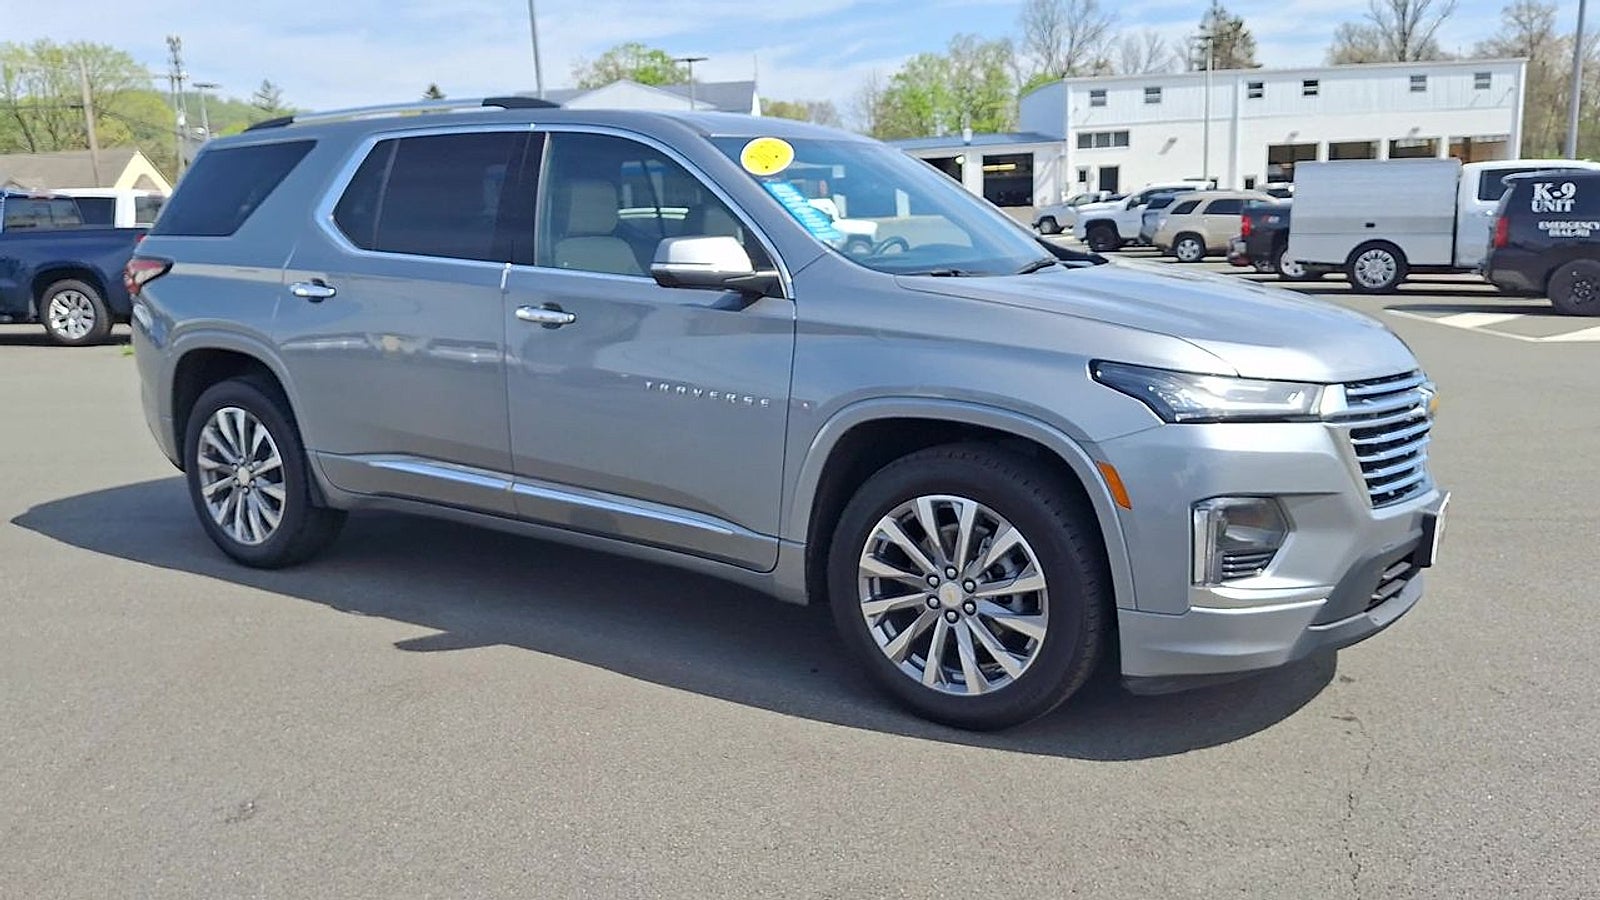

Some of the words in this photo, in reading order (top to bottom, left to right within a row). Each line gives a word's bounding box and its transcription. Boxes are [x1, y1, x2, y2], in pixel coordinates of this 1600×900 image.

[1533, 182, 1576, 199] K-9
[1531, 199, 1576, 212] UNIT
[644, 381, 770, 407] TRAVERSE
